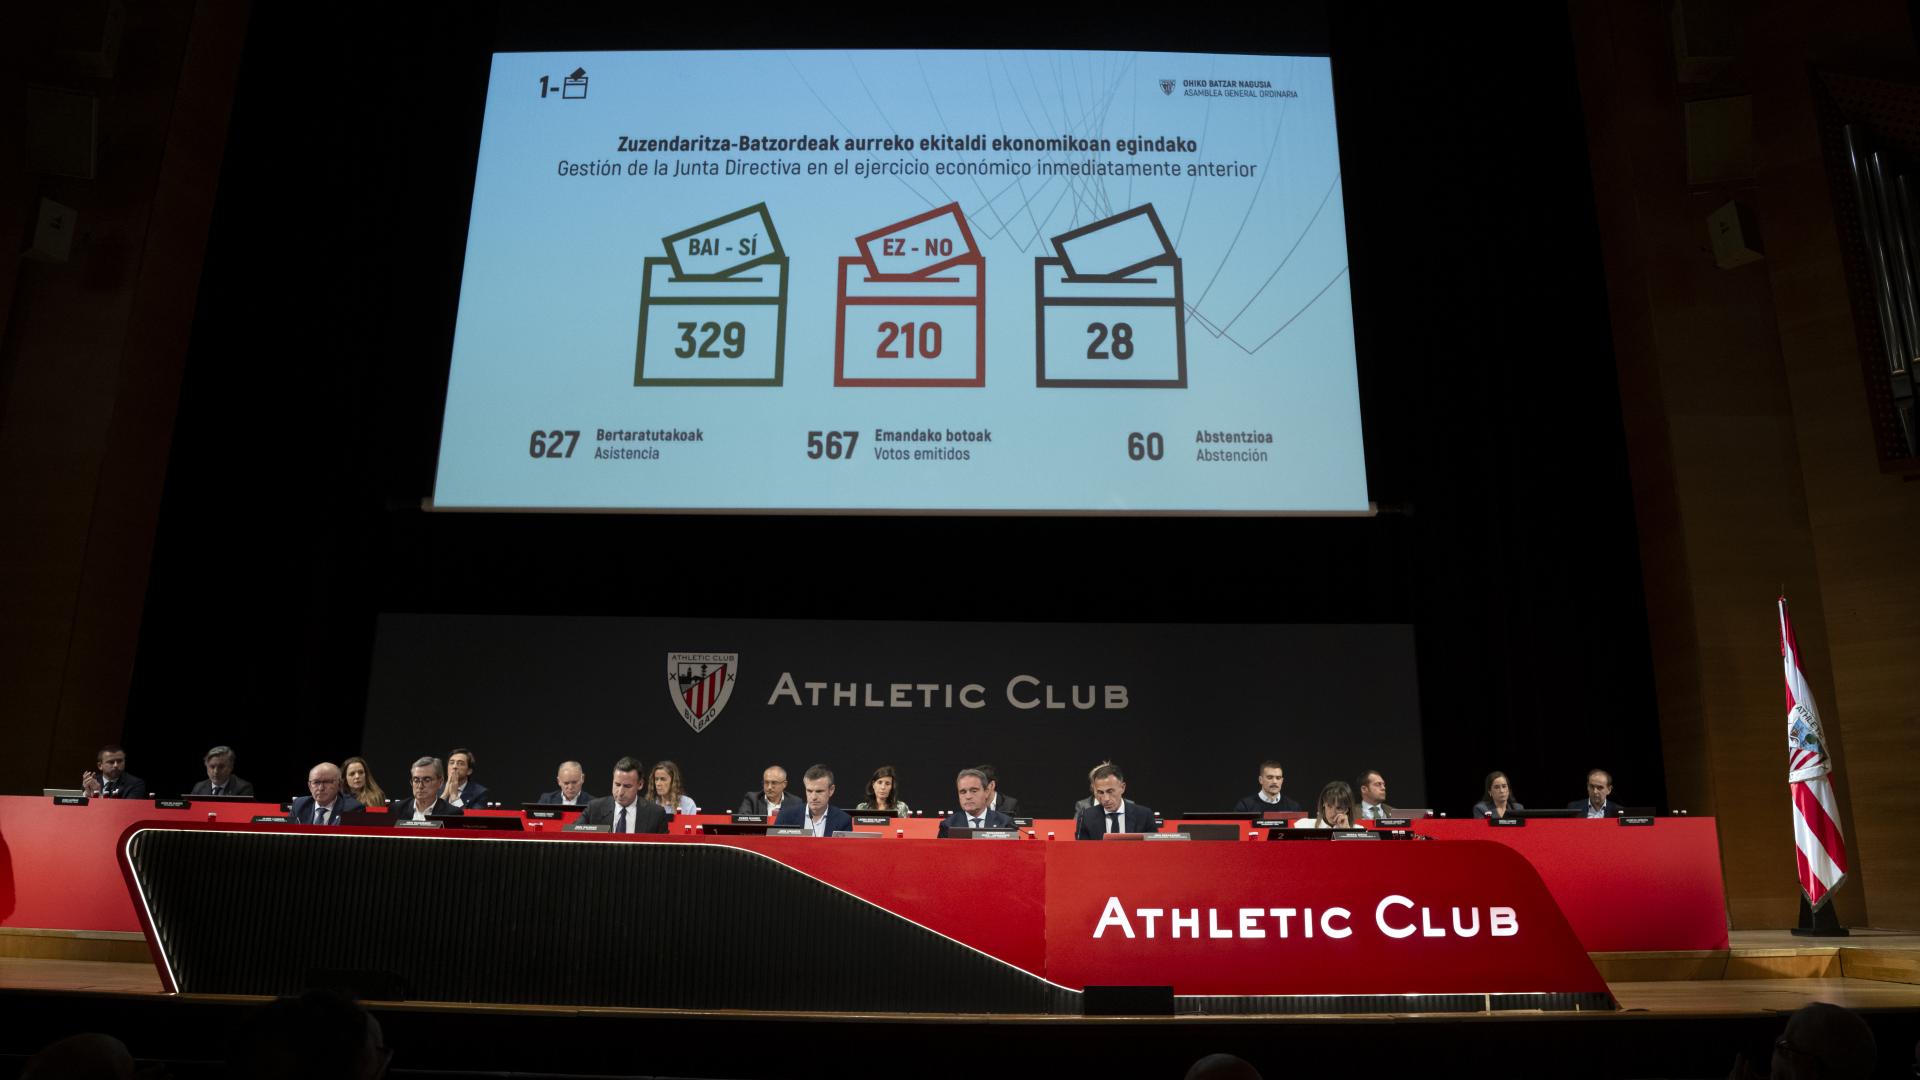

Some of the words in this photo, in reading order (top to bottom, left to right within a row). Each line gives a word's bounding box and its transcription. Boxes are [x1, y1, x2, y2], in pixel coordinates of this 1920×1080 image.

[1183, 80, 1207, 88] OHIKO
[1209, 80, 1237, 88] BATZAR
[1239, 81, 1272, 89] NAGUSIA
[1184, 89, 1223, 97] ASAMBLEA
[1225, 90, 1257, 98] GENERAL
[1260, 90, 1298, 98] ORDINARIA
[618, 135, 839, 152] Zuzendaritza-Batzordeak
[845, 135, 914, 151] aurreko
[920, 135, 986, 151] ekitaldi
[993, 135, 1110, 152] ekonomikoan
[1117, 136, 1197, 155] egindako
[557, 160, 621, 176] Gestión
[628, 160, 648, 175] de
[654, 160, 668, 175] la
[673, 160, 718, 177] Junta
[726, 159, 801, 175] Directiva
[807, 163, 827, 175] en
[834, 159, 848, 175] el
[855, 159, 929, 179] ejercicio
[936, 159, 1031, 176] económico
[1037, 159, 1181, 177] inmediatamente
[1187, 161, 1257, 177] anterior
[689, 238, 719, 256] BAI
[739, 234, 758, 256] SÍ
[883, 239, 905, 256] EZ
[925, 239, 953, 256] NO
[675, 321, 746, 359] 329
[877, 321, 943, 359] 210
[1087, 322, 1135, 360] 28
[530, 430, 580, 459] 627
[596, 429, 704, 442] Bertaratutakoak
[807, 431, 859, 460] 567
[875, 429, 942, 442] Emandako
[946, 429, 992, 442] botoak
[1195, 430, 1274, 444] Abstentzioa
[594, 446, 660, 460] Asistencia
[874, 446, 910, 460] Votos
[914, 446, 971, 460] emitidos
[1128, 432, 1164, 461] 60
[1196, 447, 1268, 462] Abstención
[768, 672, 985, 709] ATHLETIC
[1007, 675, 1128, 710] CLUB
[684, 708, 716, 730] BILBAO
[1093, 897, 1352, 939] ATHLETIC
[1376, 895, 1519, 939] CLUB
